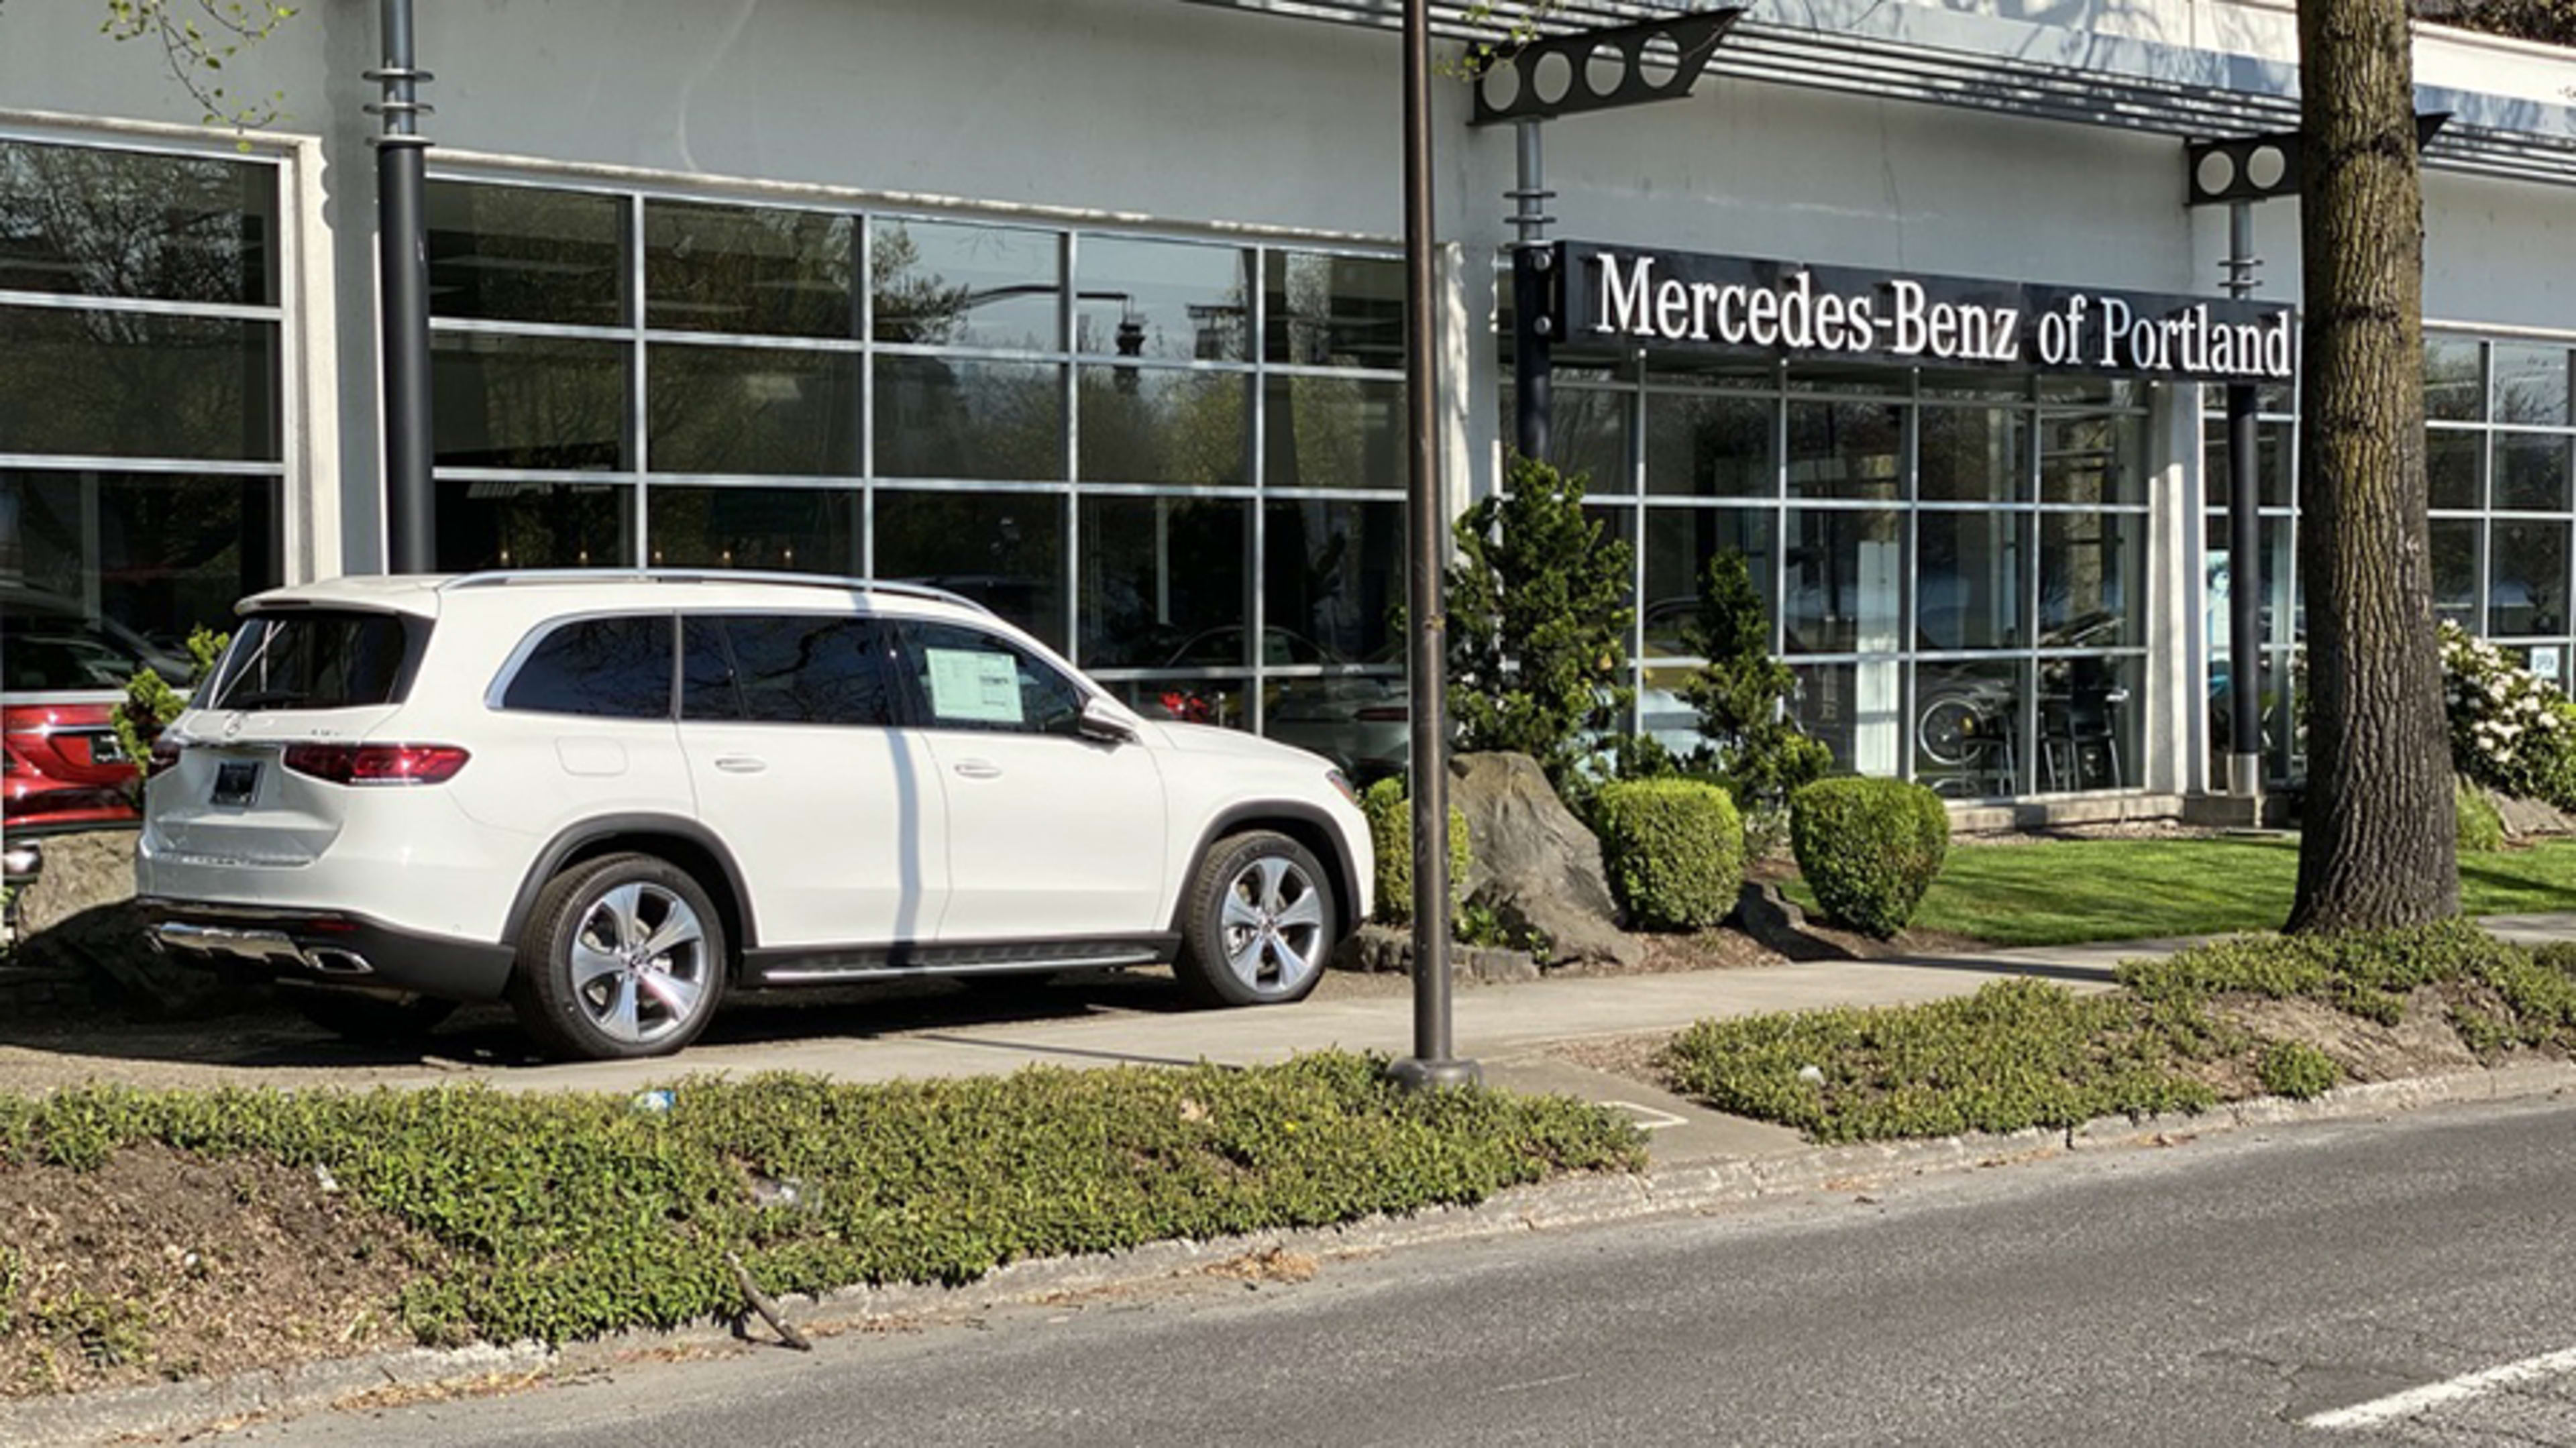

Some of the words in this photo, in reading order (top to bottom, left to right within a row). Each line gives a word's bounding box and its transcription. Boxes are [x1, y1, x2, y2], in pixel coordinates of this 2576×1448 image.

[1596, 252, 2019, 360] Mercedes-Benz
[2038, 294, 2087, 364] of
[2100, 297, 2292, 376] Portland
